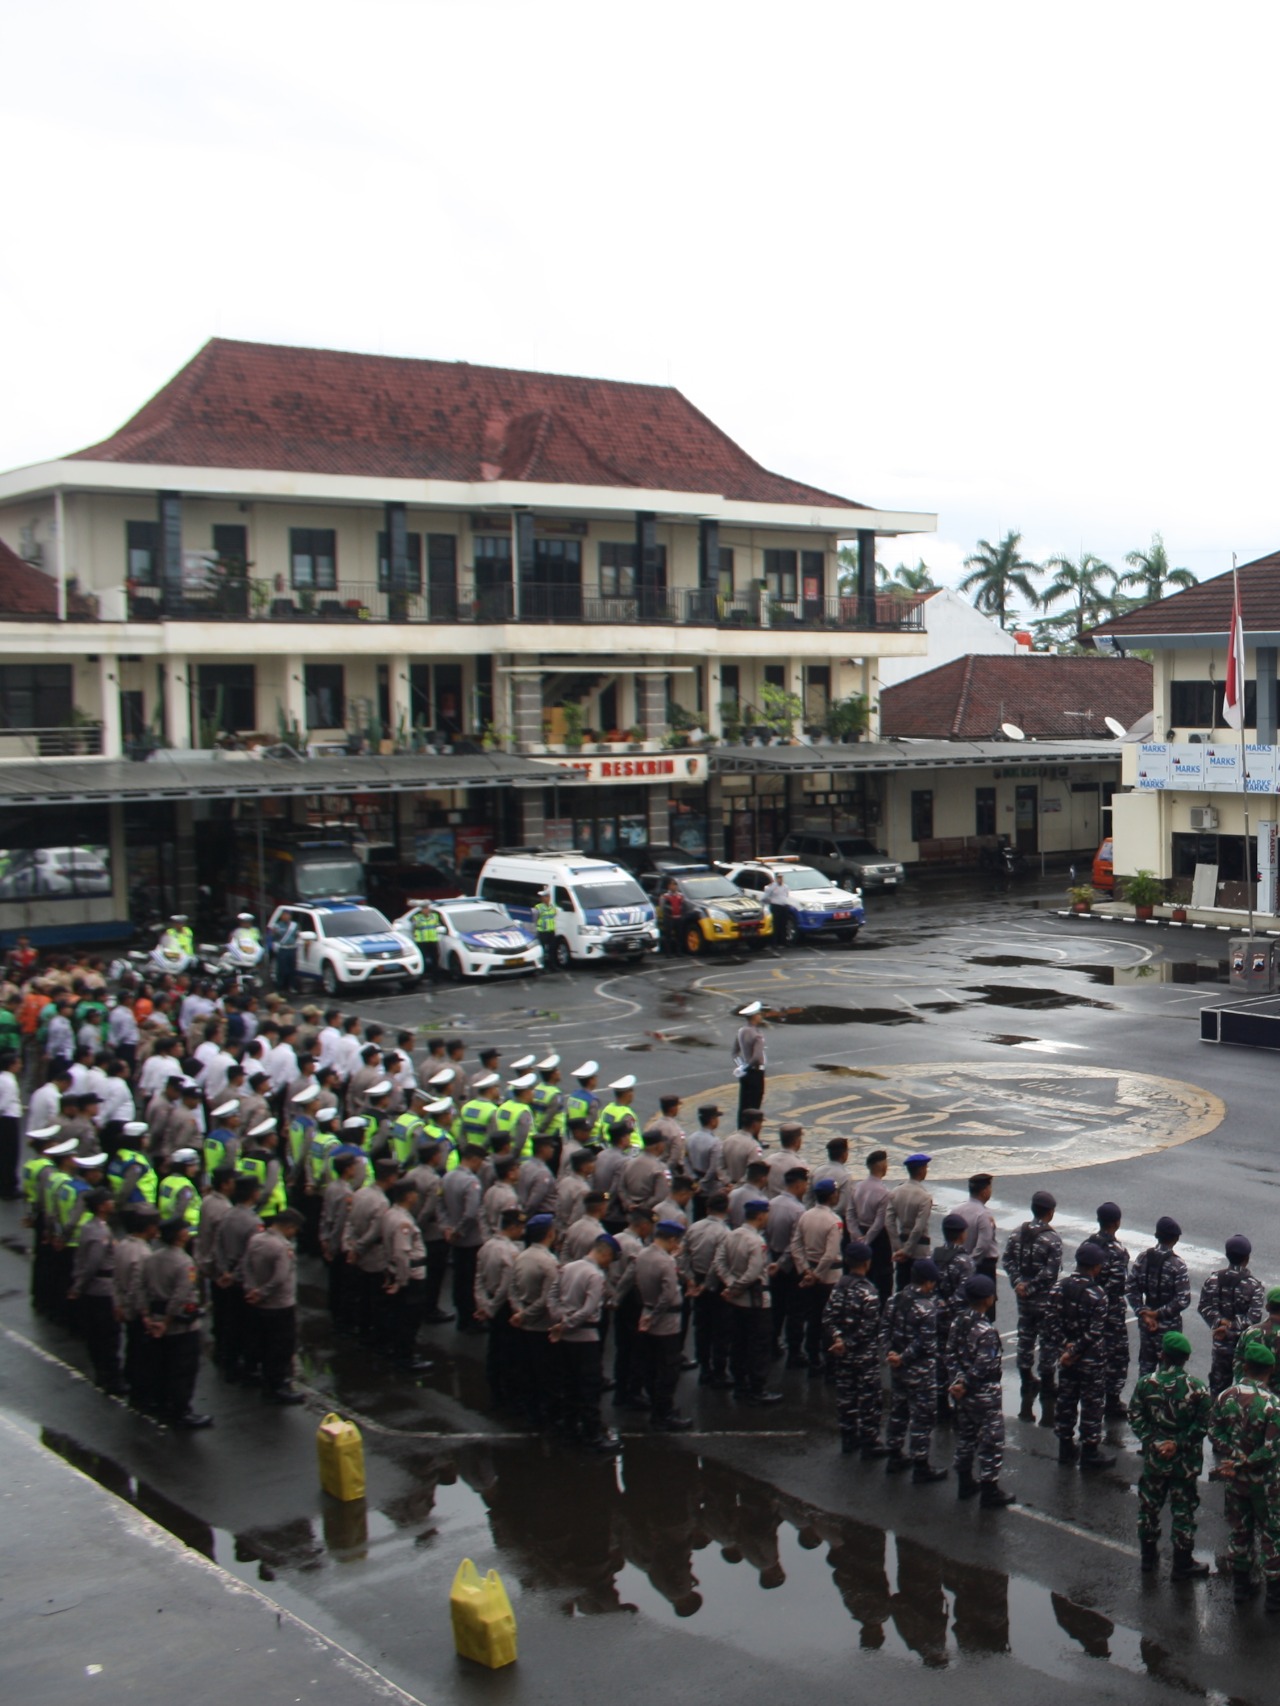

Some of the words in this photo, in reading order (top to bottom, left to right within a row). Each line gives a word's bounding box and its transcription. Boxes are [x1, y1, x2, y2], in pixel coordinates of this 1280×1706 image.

[1246, 744, 1272, 752] MARKS
[1210, 757, 1236, 765] MARKS
[601, 760, 674, 777] RESKRIM
[1175, 765, 1200, 773] MARKS
[1140, 780, 1165, 788] MARKS
